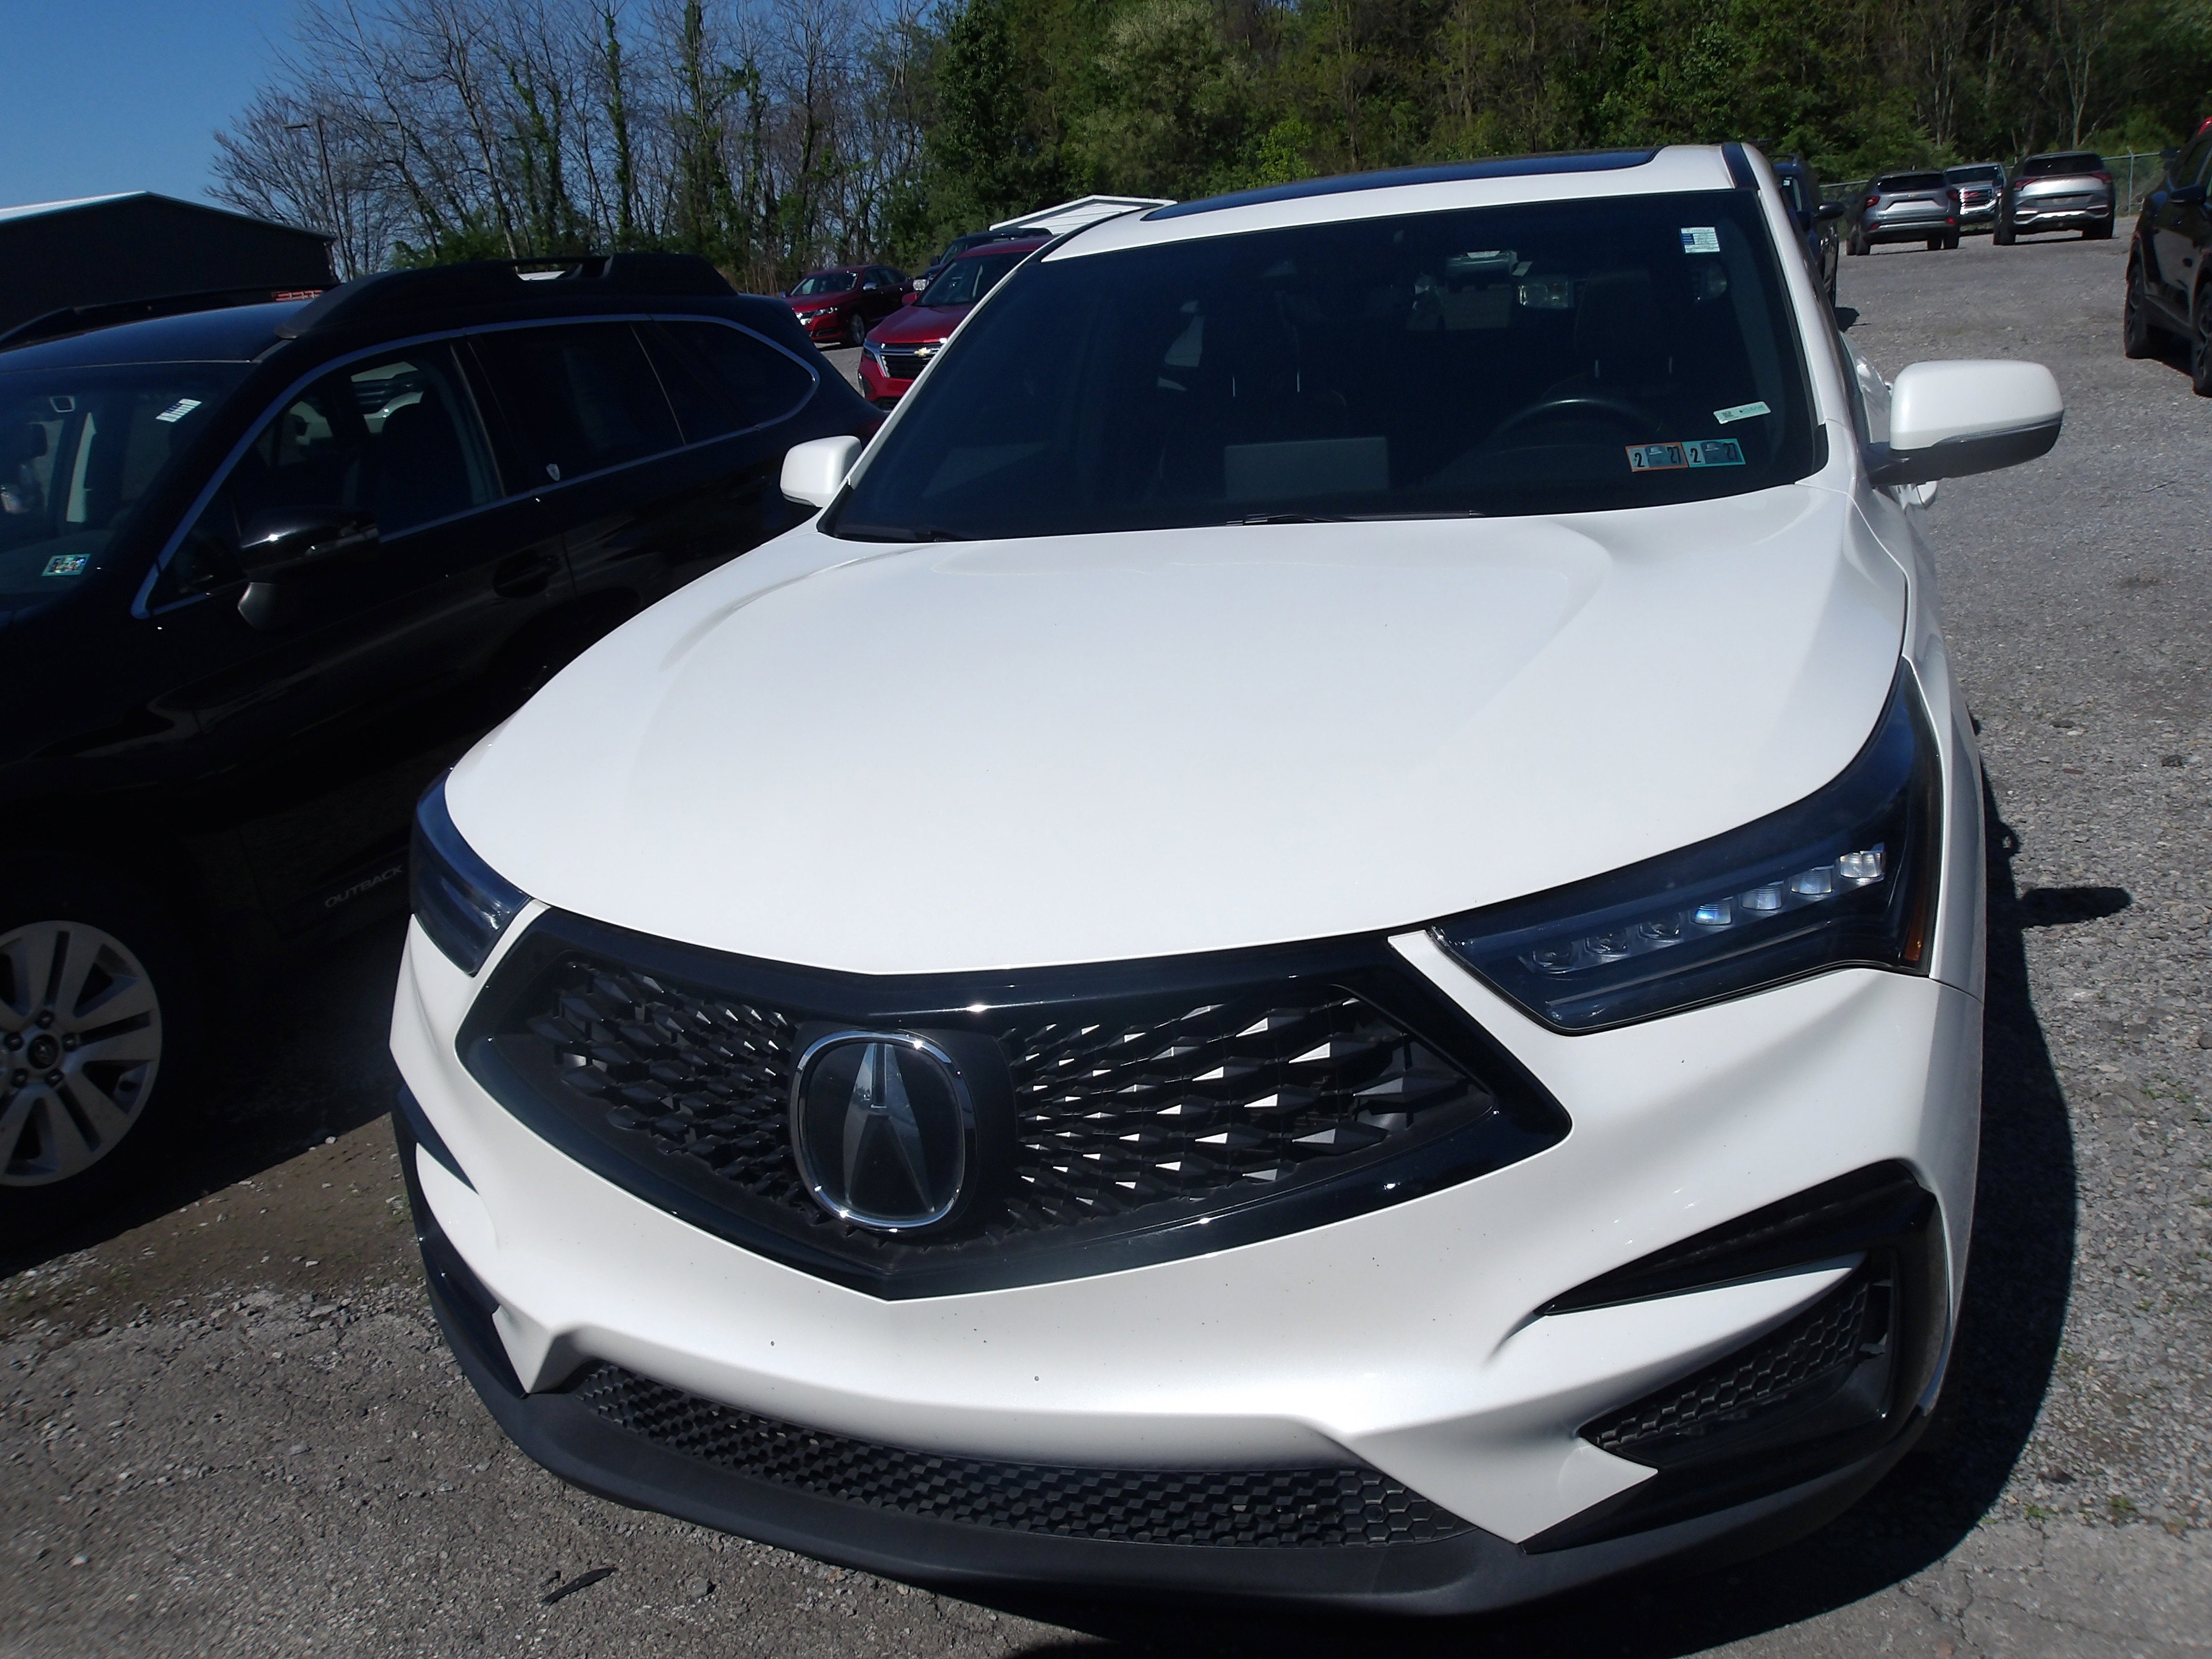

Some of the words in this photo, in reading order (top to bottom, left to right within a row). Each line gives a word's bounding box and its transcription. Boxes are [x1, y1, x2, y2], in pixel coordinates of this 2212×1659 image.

[1635, 452, 1645, 467] 2
[1690, 447, 1701, 463] 2
[325, 865, 402, 907] OUTBACK
